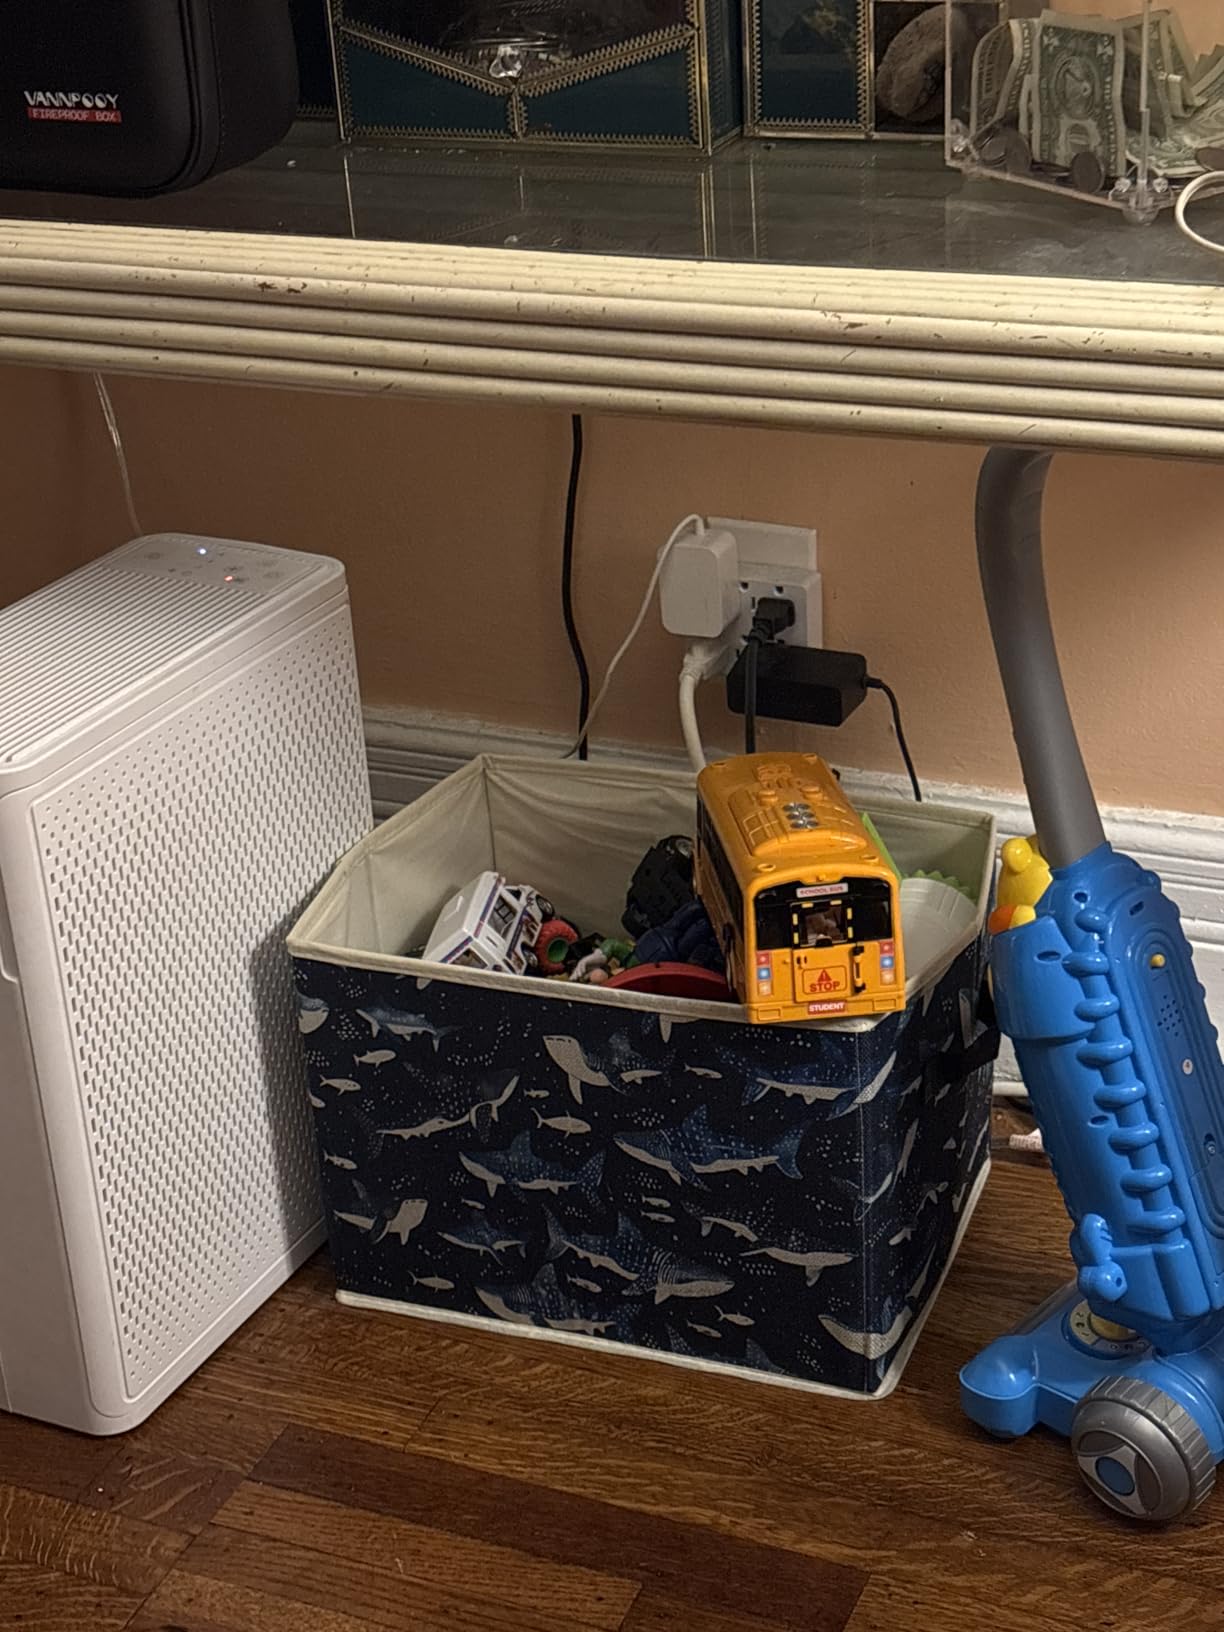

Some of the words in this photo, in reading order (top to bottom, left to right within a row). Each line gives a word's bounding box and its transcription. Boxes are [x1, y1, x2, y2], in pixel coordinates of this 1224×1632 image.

[32, 108, 89, 120] FIREPROOF
[95, 111, 115, 122] BOX
[810, 981, 840, 992] STOP
[809, 1002, 844, 1012] STUDENT
